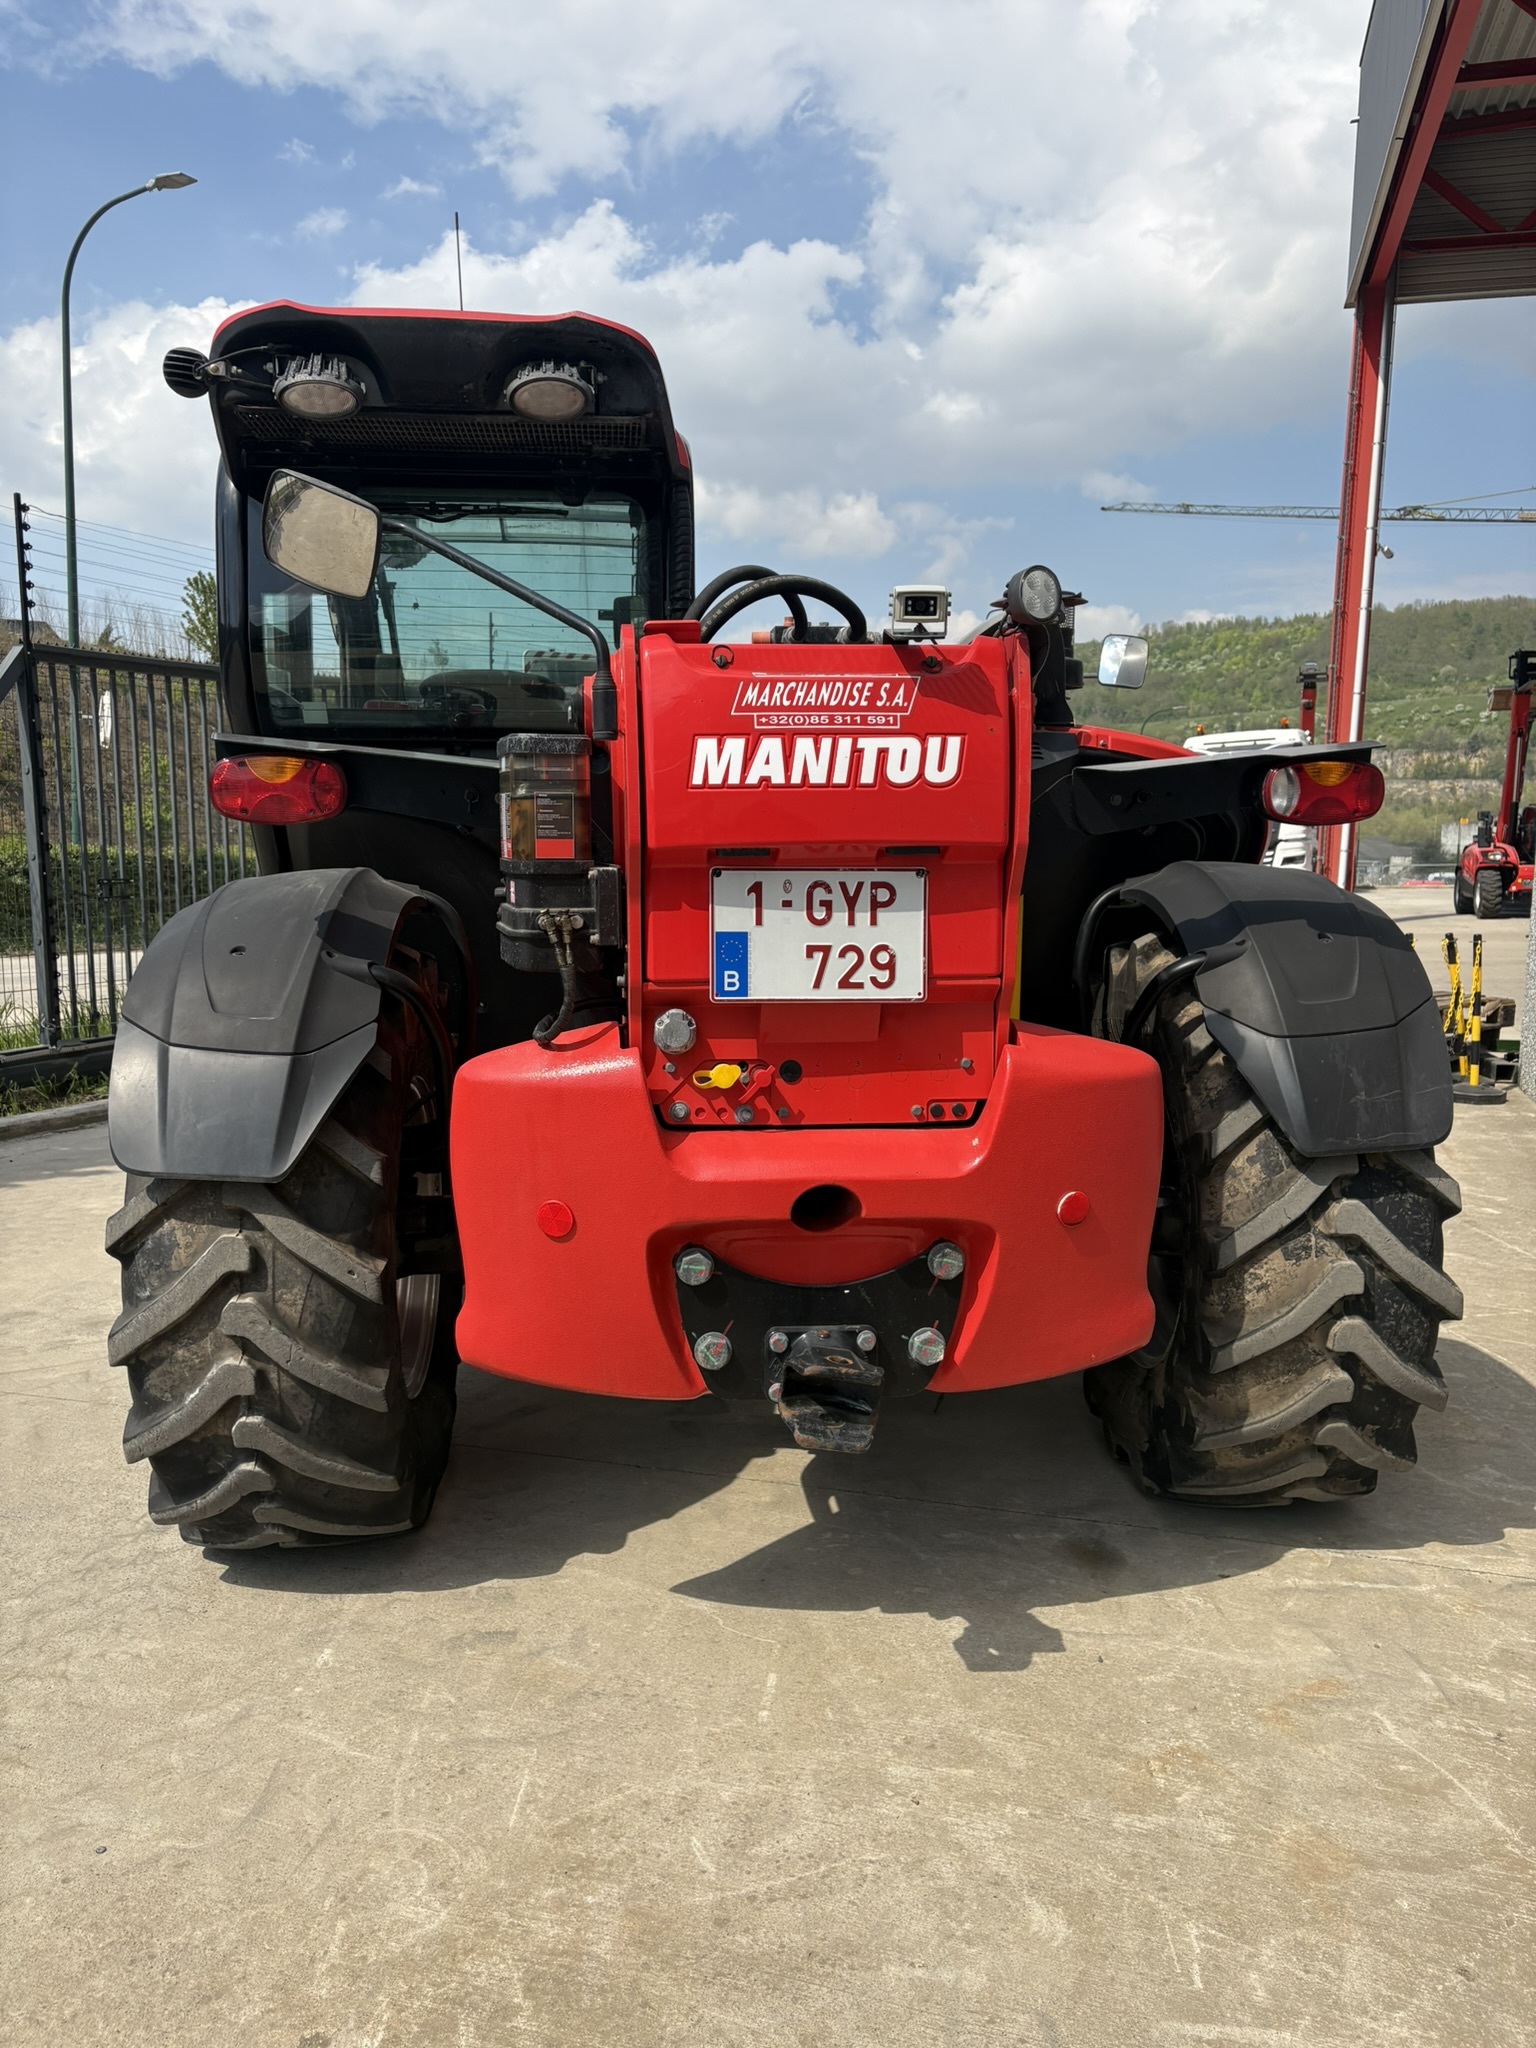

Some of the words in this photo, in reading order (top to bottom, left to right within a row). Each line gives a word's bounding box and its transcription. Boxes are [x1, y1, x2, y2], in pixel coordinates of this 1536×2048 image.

[741, 681, 874, 707] MARCHANDISE
[876, 682, 909, 707] S.A.
[759, 715, 829, 726] +32(0)85
[833, 715, 861, 724] 311
[867, 716, 894, 725] 591
[690, 736, 962, 786] MANITOU
[804, 943, 897, 990] 729
[723, 970, 740, 992] B
[855, 1060, 861, 1068] 3
[897, 1053, 903, 1061] 2
